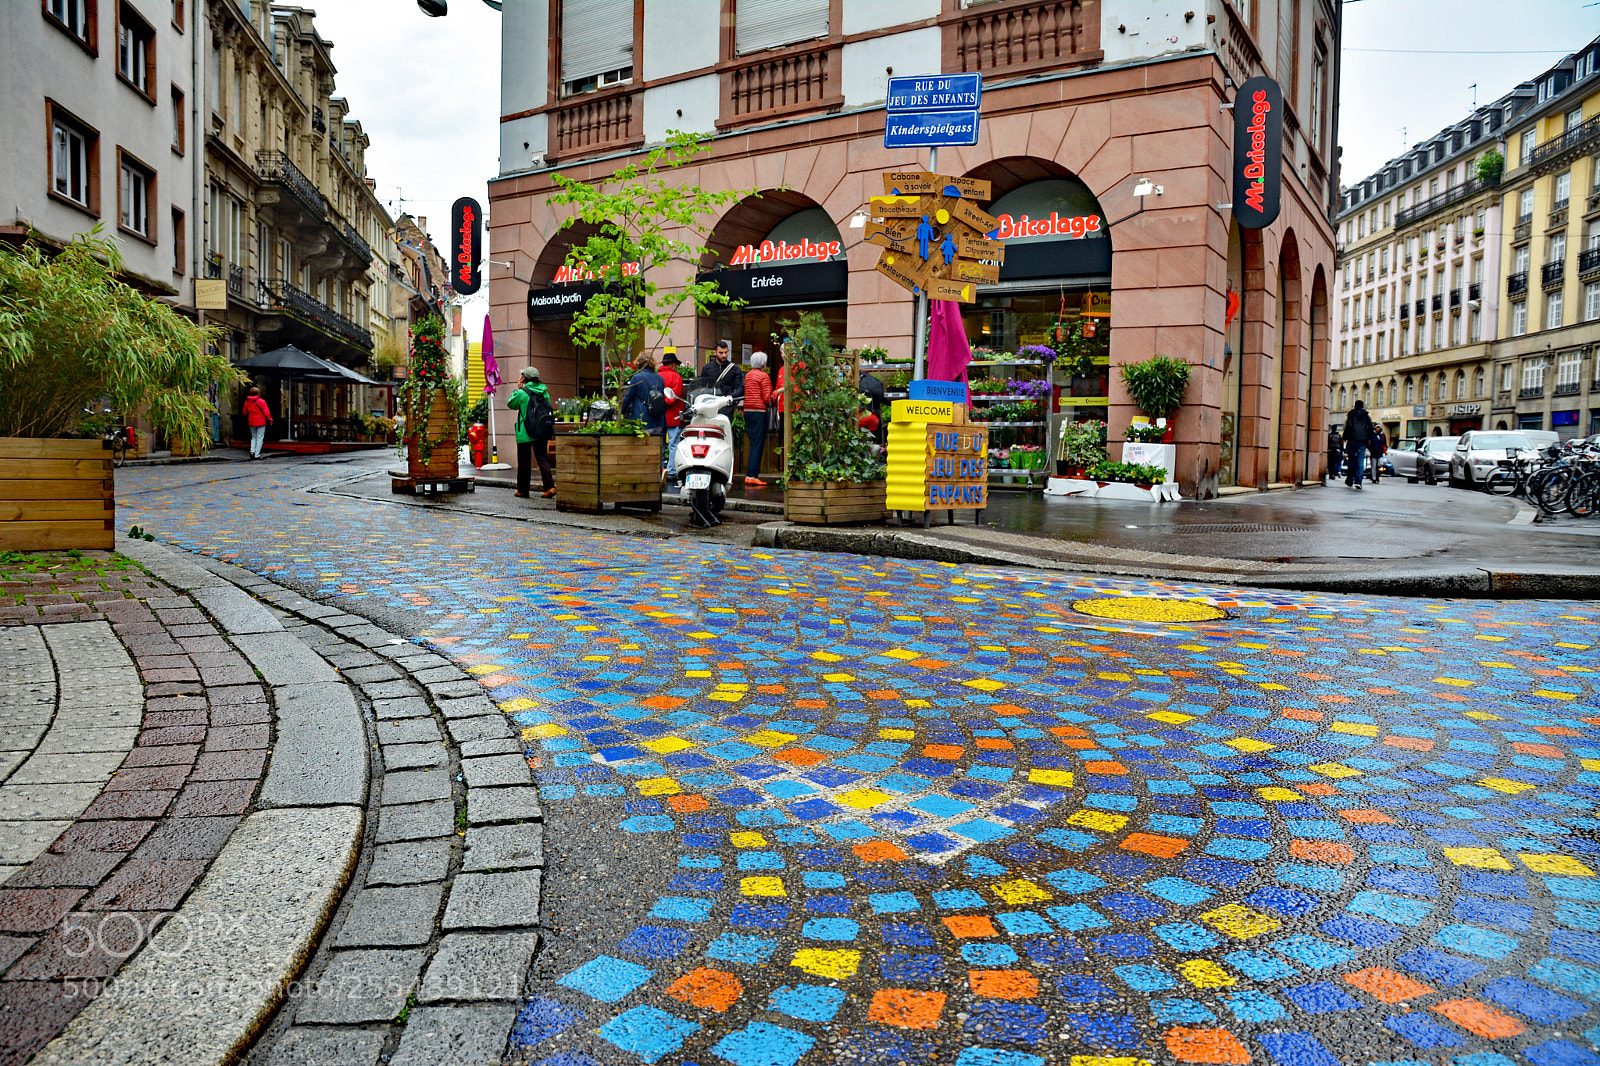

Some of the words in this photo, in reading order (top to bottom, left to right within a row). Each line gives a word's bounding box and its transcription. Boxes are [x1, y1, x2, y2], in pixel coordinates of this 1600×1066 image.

[915, 81, 934, 92] RUE
[938, 80, 951, 90] DU
[889, 96, 907, 106] JEU
[911, 95, 928, 105] DES
[932, 93, 975, 104] ENFANTS
[890, 123, 973, 136] Kinderspielgass
[1243, 89, 1271, 214] Mr.Bricolage
[891, 173, 920, 181] Cabane
[950, 176, 975, 186] Espace
[904, 182, 909, 190] à
[963, 188, 985, 197] enfant
[963, 208, 994, 230] Street-Art
[885, 227, 902, 239] Bien
[458, 205, 475, 286] Mr.Bricolage
[889, 241, 905, 252] être
[964, 237, 989, 247] Terrasse
[729, 237, 841, 265] Mr.Bricolage
[878, 259, 915, 287] Restaurants
[960, 273, 996, 285] Commerces
[751, 274, 784, 289] Entrée
[937, 286, 961, 296] Cinéma
[926, 385, 965, 397] BIENVENUE
[906, 406, 951, 416] WELCOME
[935, 432, 959, 451] RUE
[963, 433, 983, 452] DU
[930, 458, 954, 477] JEU
[960, 459, 984, 477] DES
[930, 485, 984, 504] ENFANTS
